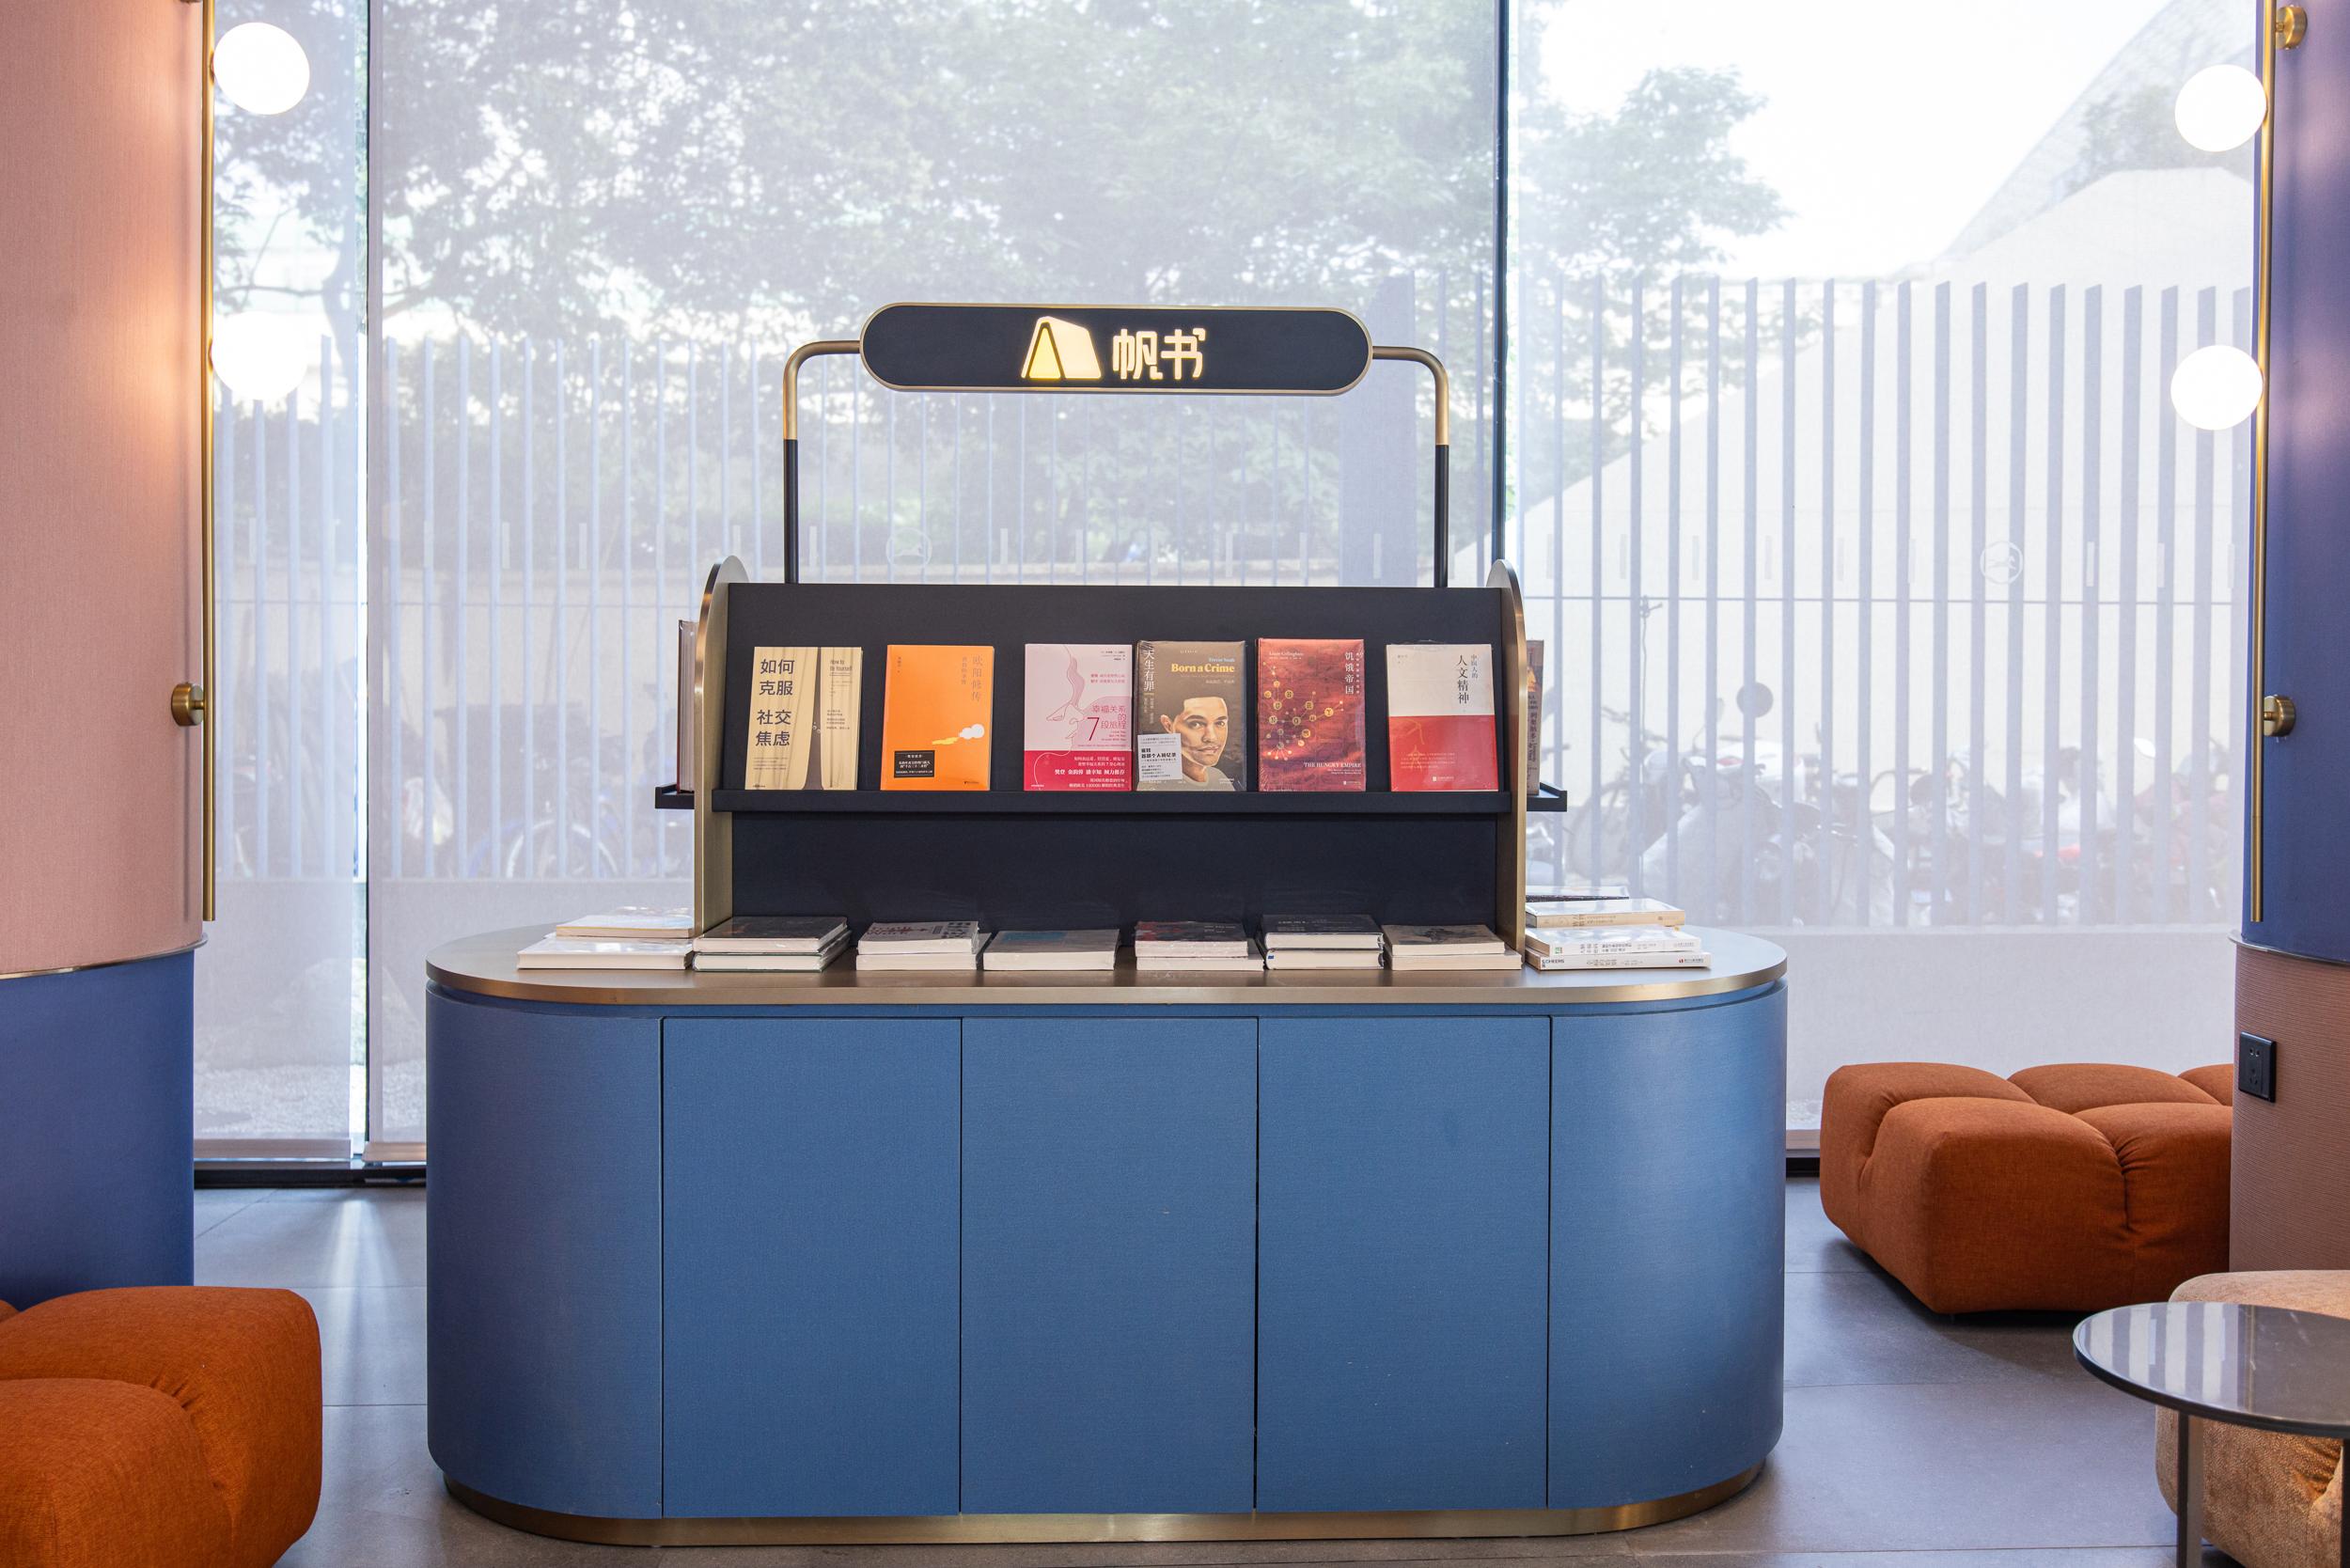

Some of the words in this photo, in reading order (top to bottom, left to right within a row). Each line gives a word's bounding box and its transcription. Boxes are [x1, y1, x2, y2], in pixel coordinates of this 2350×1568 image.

[1112, 326, 1207, 381] 帆书
[760, 658, 795, 675] 如何
[1143, 650, 1155, 692] 天生有罪
[1171, 663, 1197, 672] Born
[1204, 663, 1235, 673] Crime
[1457, 654, 1469, 704] 人文精神
[759, 680, 793, 697] 克服
[756, 709, 792, 726] 社交
[1091, 705, 1126, 713] 幸福关系
[1086, 716, 1101, 742] 7
[755, 730, 791, 746] 焦虑
